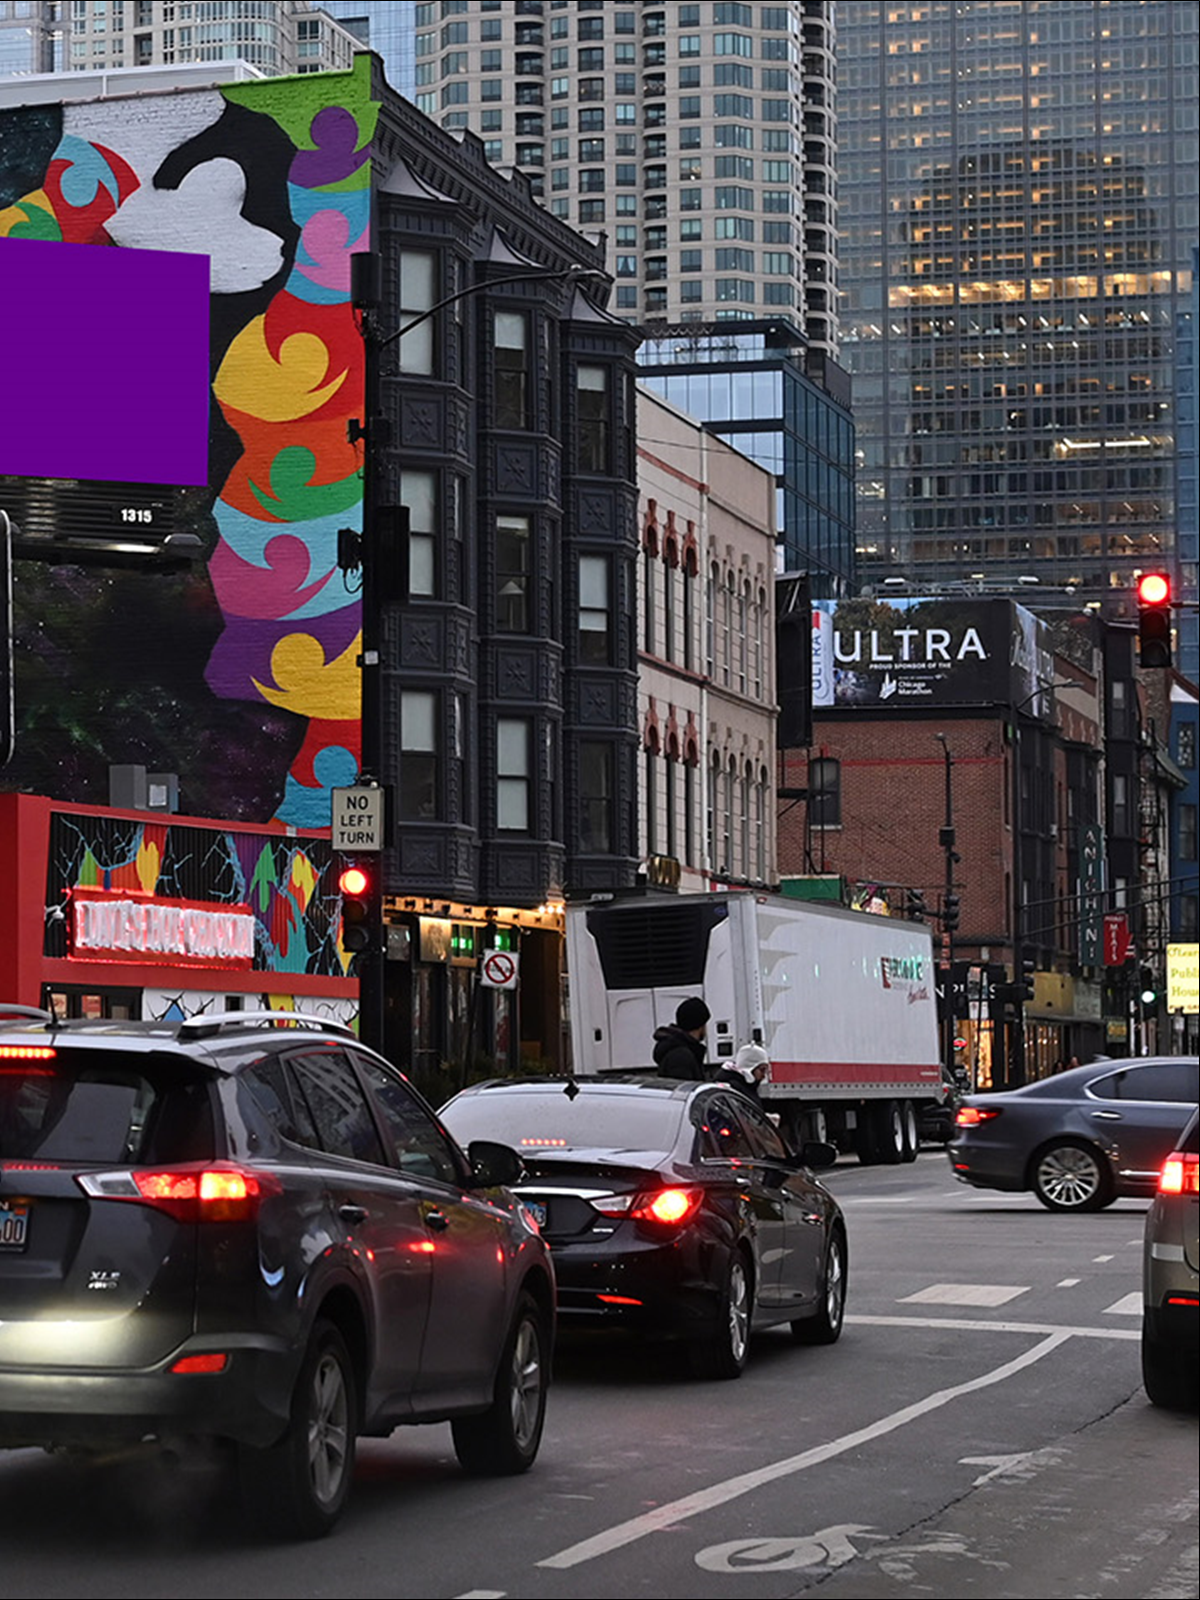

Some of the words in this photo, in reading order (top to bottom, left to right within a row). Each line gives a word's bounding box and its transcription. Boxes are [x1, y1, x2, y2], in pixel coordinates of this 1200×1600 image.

[121, 508, 153, 524] 1315
[833, 627, 987, 663] ULTRA
[869, 662, 893, 670] PROUD
[894, 662, 926, 670] SPONSOR
[898, 681, 926, 690] Chicago
[346, 795, 369, 810] NO
[341, 814, 374, 827] LEFT
[339, 831, 374, 844] TURN
[90, 1271, 120, 1281] XLE
